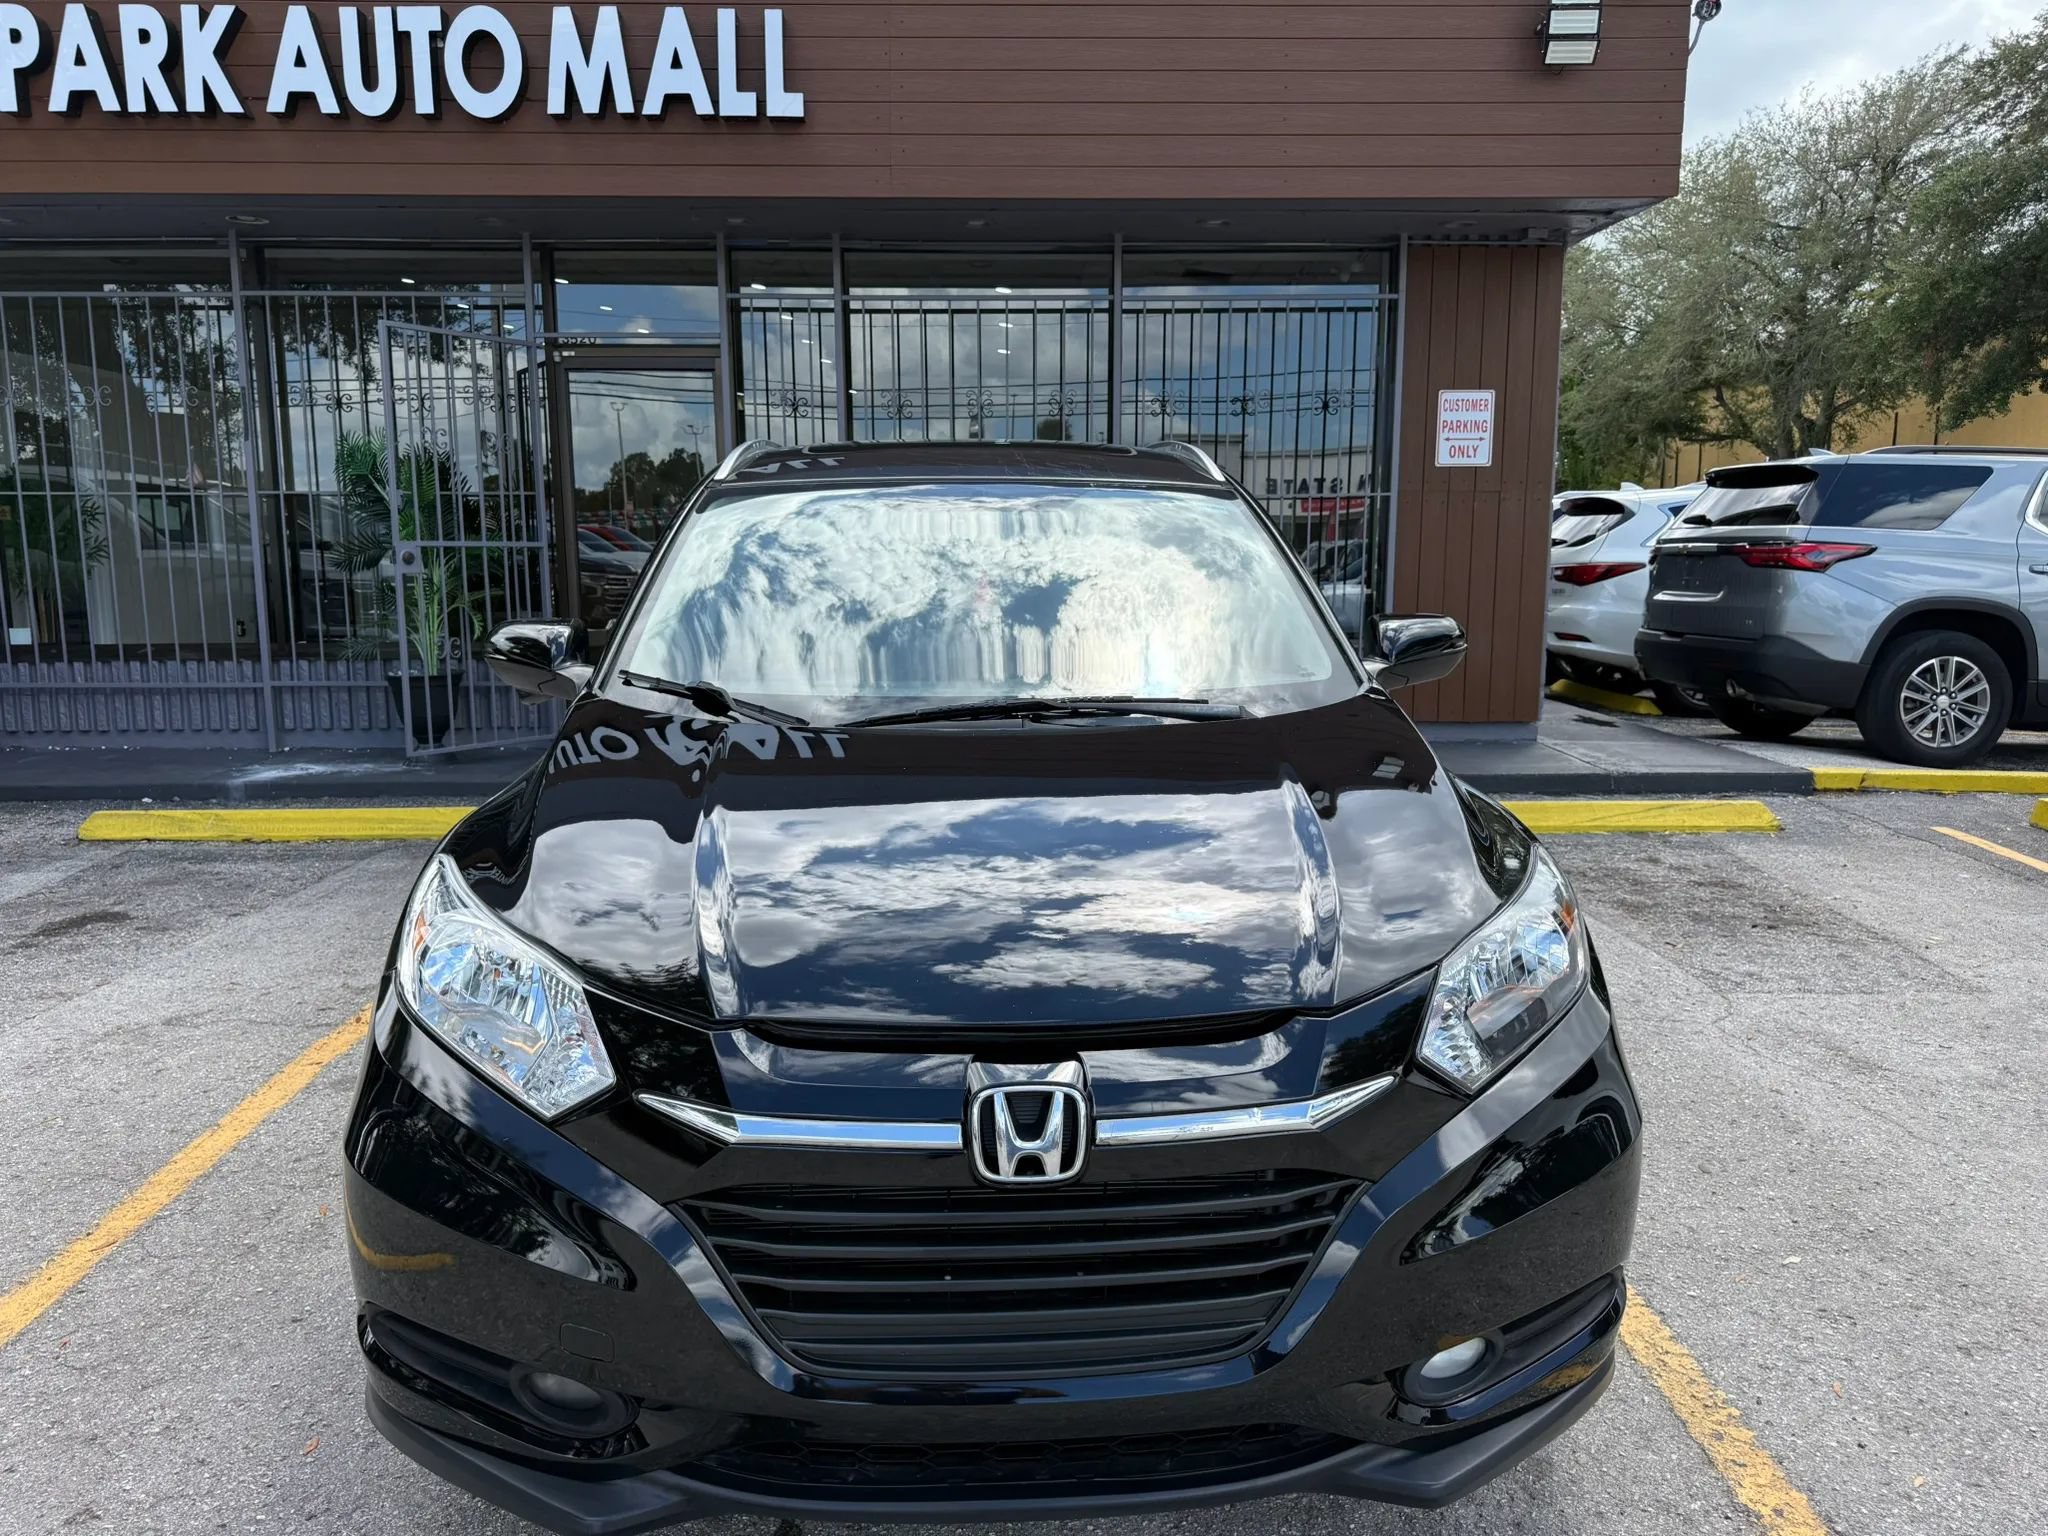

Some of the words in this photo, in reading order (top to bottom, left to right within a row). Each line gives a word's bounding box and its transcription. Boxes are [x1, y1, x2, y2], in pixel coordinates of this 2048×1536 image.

[0, 3, 246, 115] PARK
[266, 4, 525, 120] AUTO
[547, 5, 806, 119] MALL
[1442, 398, 1489, 412] CUSTOMER
[1441, 420, 1488, 433] PARKING
[1449, 444, 1479, 458] ONLY
